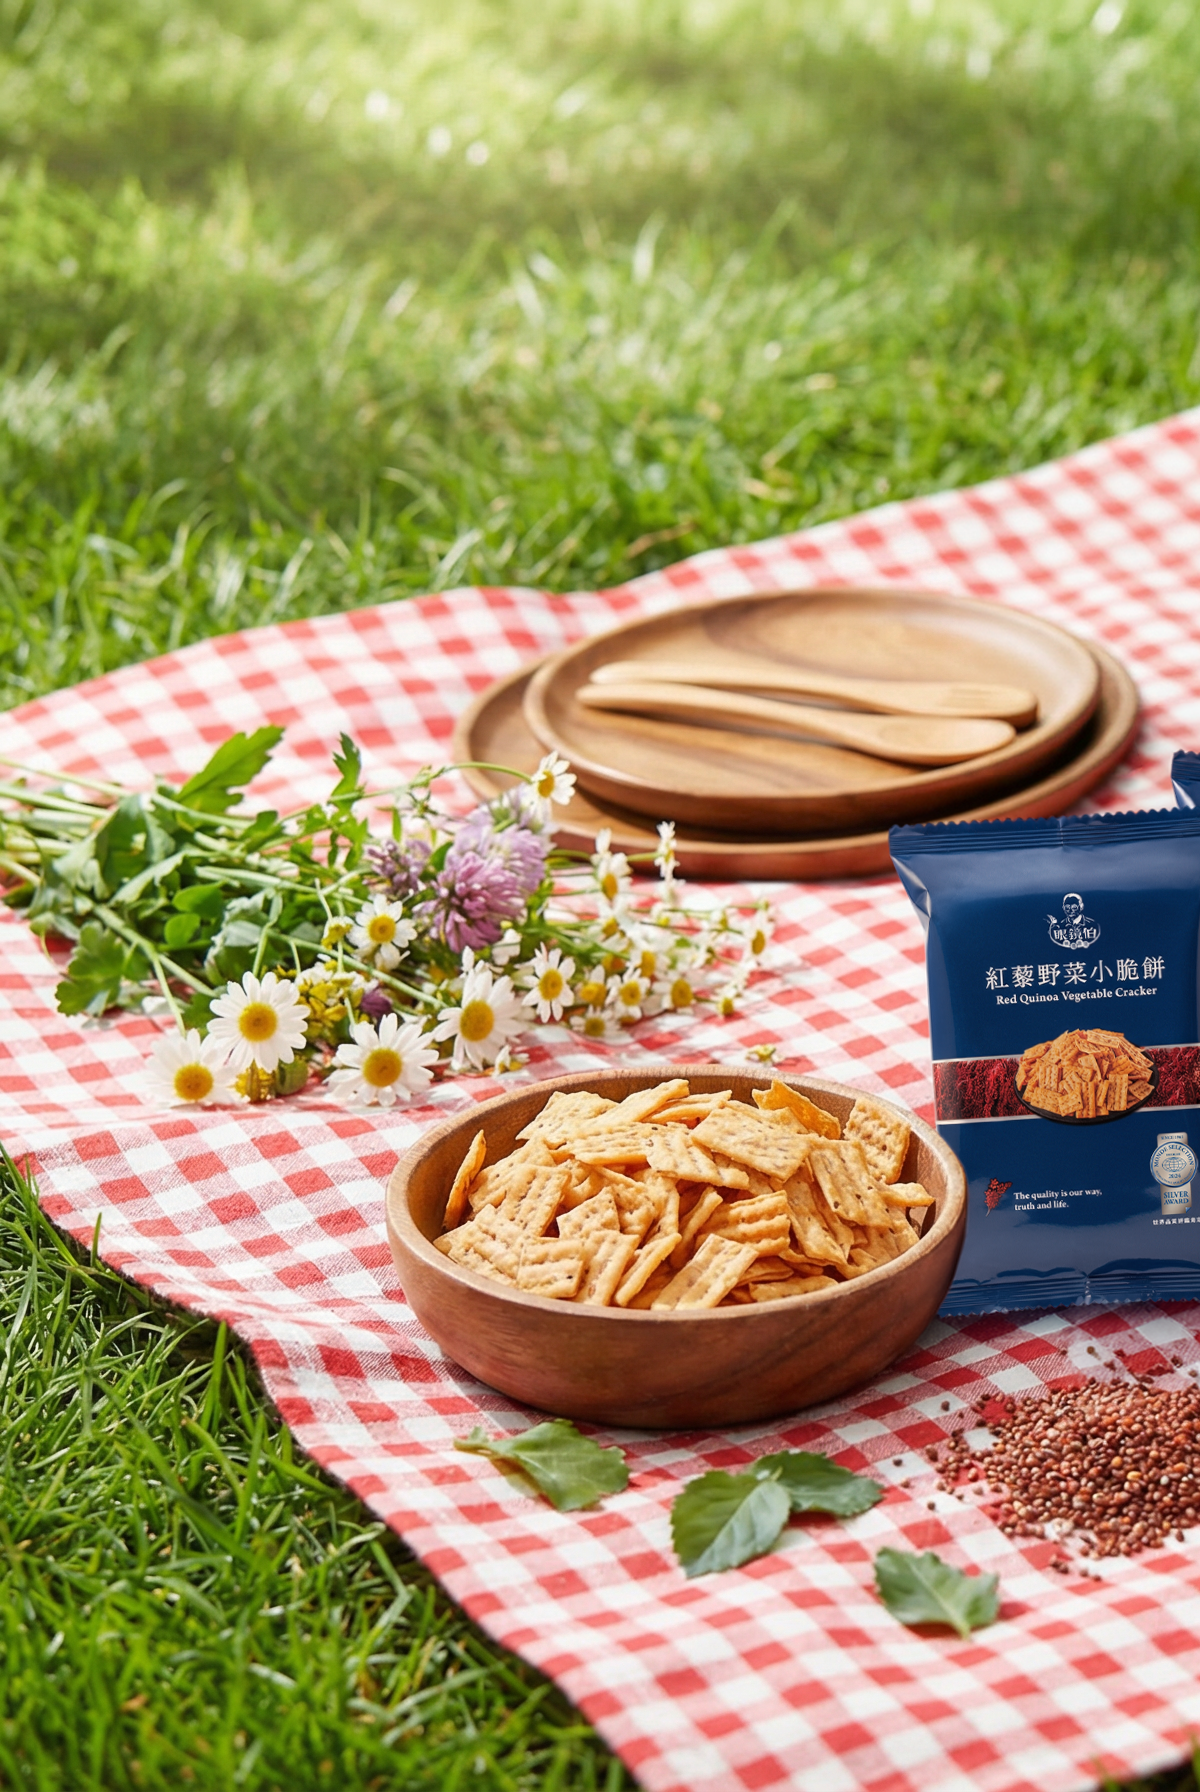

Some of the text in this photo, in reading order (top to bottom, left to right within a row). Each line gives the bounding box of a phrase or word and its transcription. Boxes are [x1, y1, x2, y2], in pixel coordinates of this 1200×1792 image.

[1053, 926, 1097, 941] 眼鏡伯
[985, 955, 1166, 990] 紅藜野菜小脆餅
[996, 985, 1158, 1006] Red Quinoa Vegetable Cracker
[1154, 1144, 1194, 1168] MONDE SELECTION
[1013, 1192, 1030, 1200] The
[1031, 1190, 1059, 1201] quality
[1085, 1189, 1102, 1197] way,
[1163, 1190, 1189, 1199] SILVER
[1014, 1200, 1069, 1211] truth and life.
